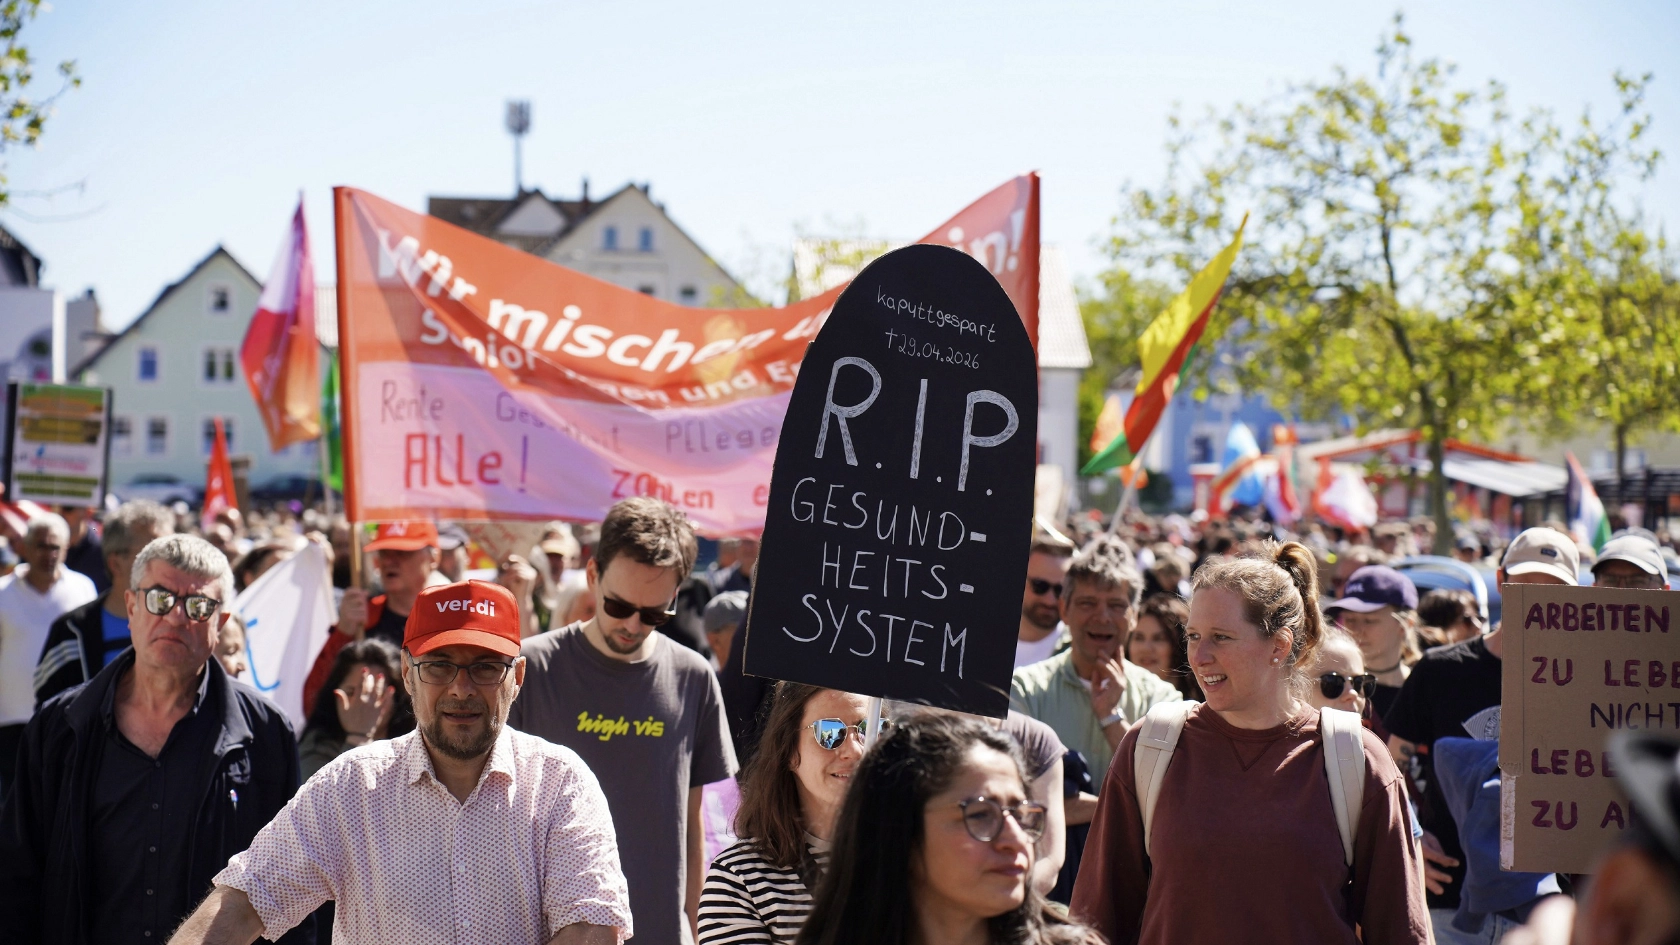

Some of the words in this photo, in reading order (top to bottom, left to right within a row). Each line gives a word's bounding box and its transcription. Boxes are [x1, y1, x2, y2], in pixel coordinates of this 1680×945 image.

[378, 229, 478, 301] Wir
[487, 299, 777, 373] mischen
[877, 284, 997, 343] kaputtgespart
[679, 367, 759, 402] und
[814, 356, 1020, 496] R.I.P.
[791, 476, 987, 550] GESUND-
[822, 541, 975, 600] HEITS-
[435, 598, 496, 617] ver.di
[1524, 602, 1670, 633] ARBEITEN
[782, 594, 967, 680] SYSTEM
[1531, 656, 1573, 686] ZU
[577, 710, 630, 742] high
[633, 716, 665, 738] vis
[1590, 702, 1680, 730] NICHT
[1531, 748, 1621, 778] LEBE
[1531, 800, 1578, 830] ZU
